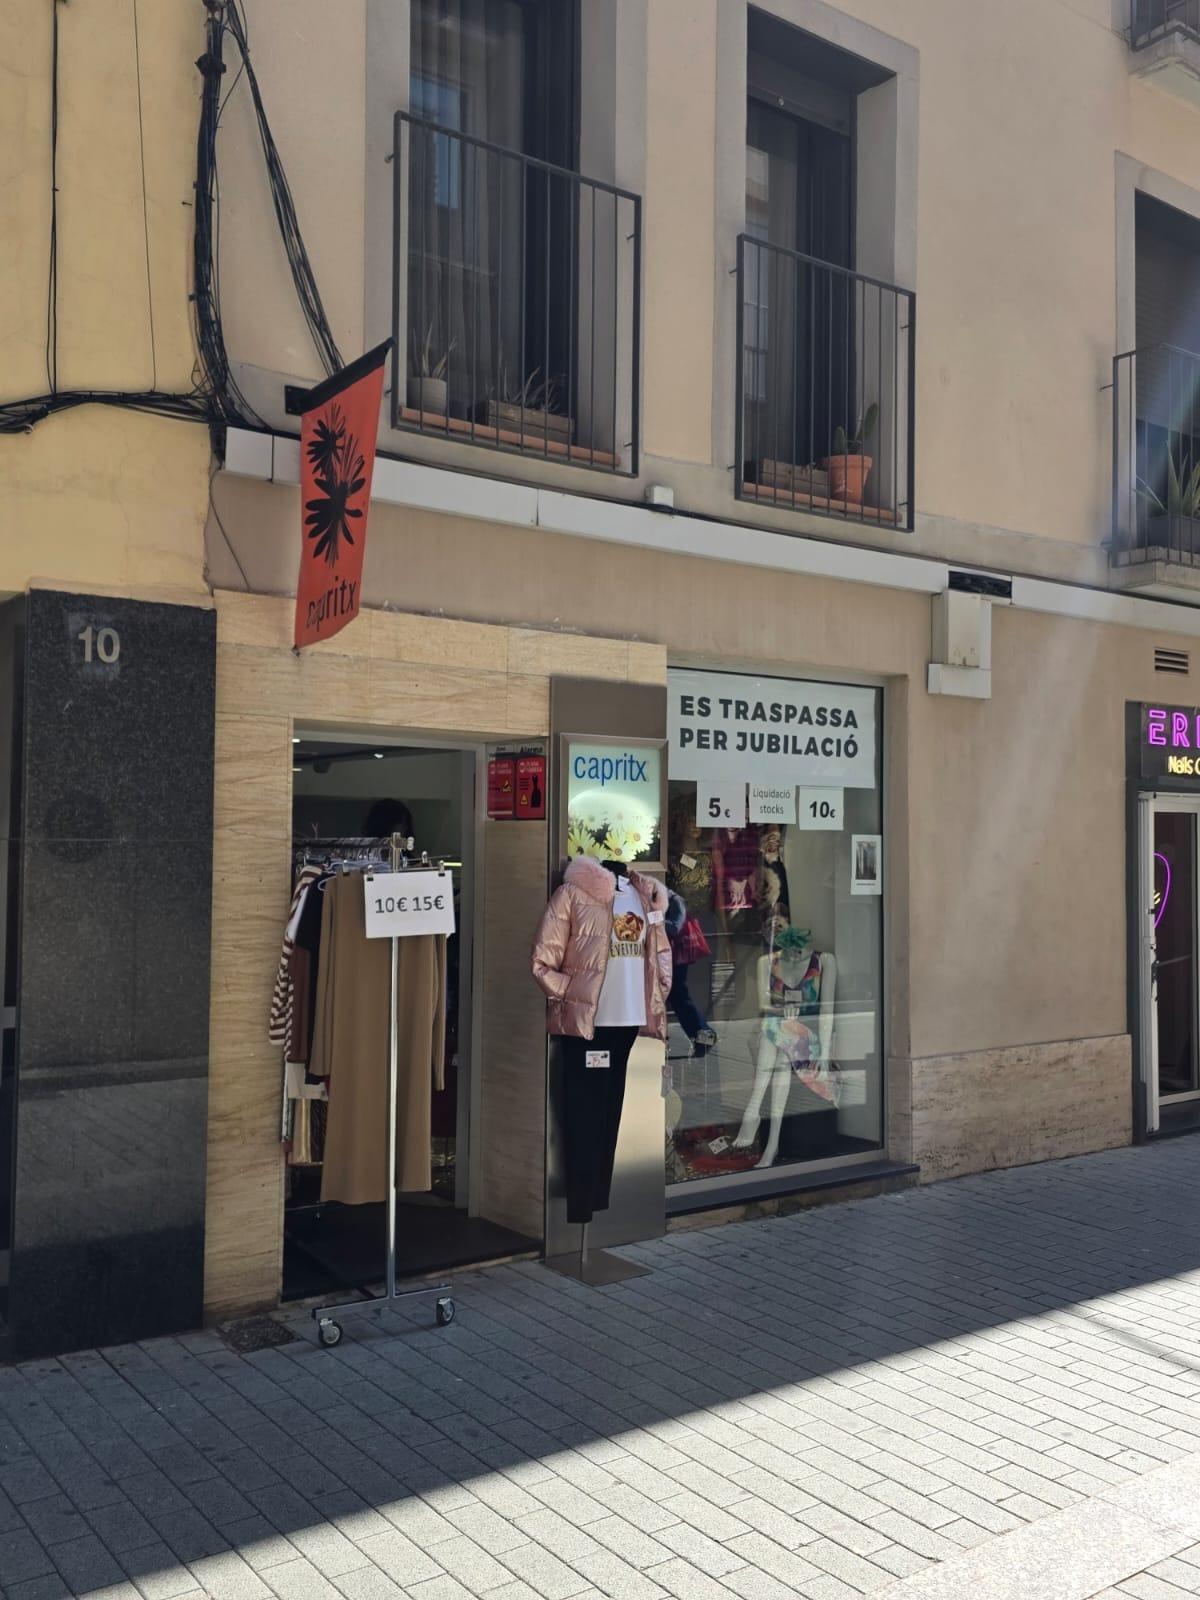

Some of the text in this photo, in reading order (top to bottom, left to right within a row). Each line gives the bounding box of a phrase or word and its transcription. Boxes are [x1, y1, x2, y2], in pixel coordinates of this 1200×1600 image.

[78, 626, 120, 663] 10
[680, 695, 858, 729] ES TRASPASSA
[680, 728, 858, 758] PER JUBILACIÓ
[574, 752, 647, 786] capritx
[1168, 755, 1194, 775] Nails
[752, 789, 790, 801] Liquidació
[759, 804, 784, 815] stocks
[809, 801, 836, 818] 10€
[375, 895, 445, 913] 10€ 15€
